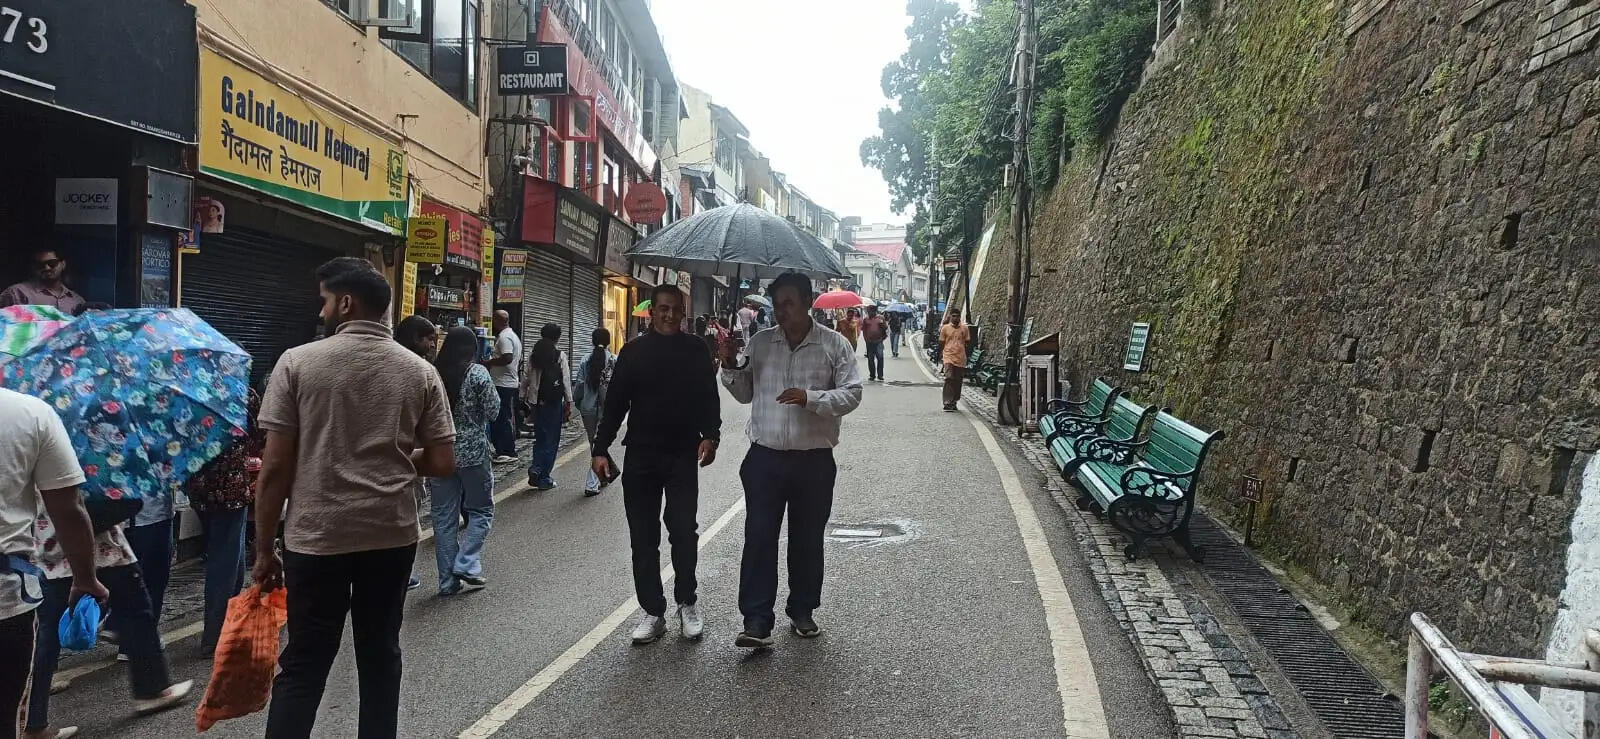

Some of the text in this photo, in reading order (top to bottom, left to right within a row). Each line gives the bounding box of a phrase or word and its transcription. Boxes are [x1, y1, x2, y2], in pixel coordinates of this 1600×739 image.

[500, 72, 563, 90] RESTAURANT
[221, 76, 319, 152] Gaindamull
[324, 126, 370, 181] Hemraj
[221, 119, 322, 192] गैंदामल हेमराज
[63, 193, 110, 203] JOCKEY
